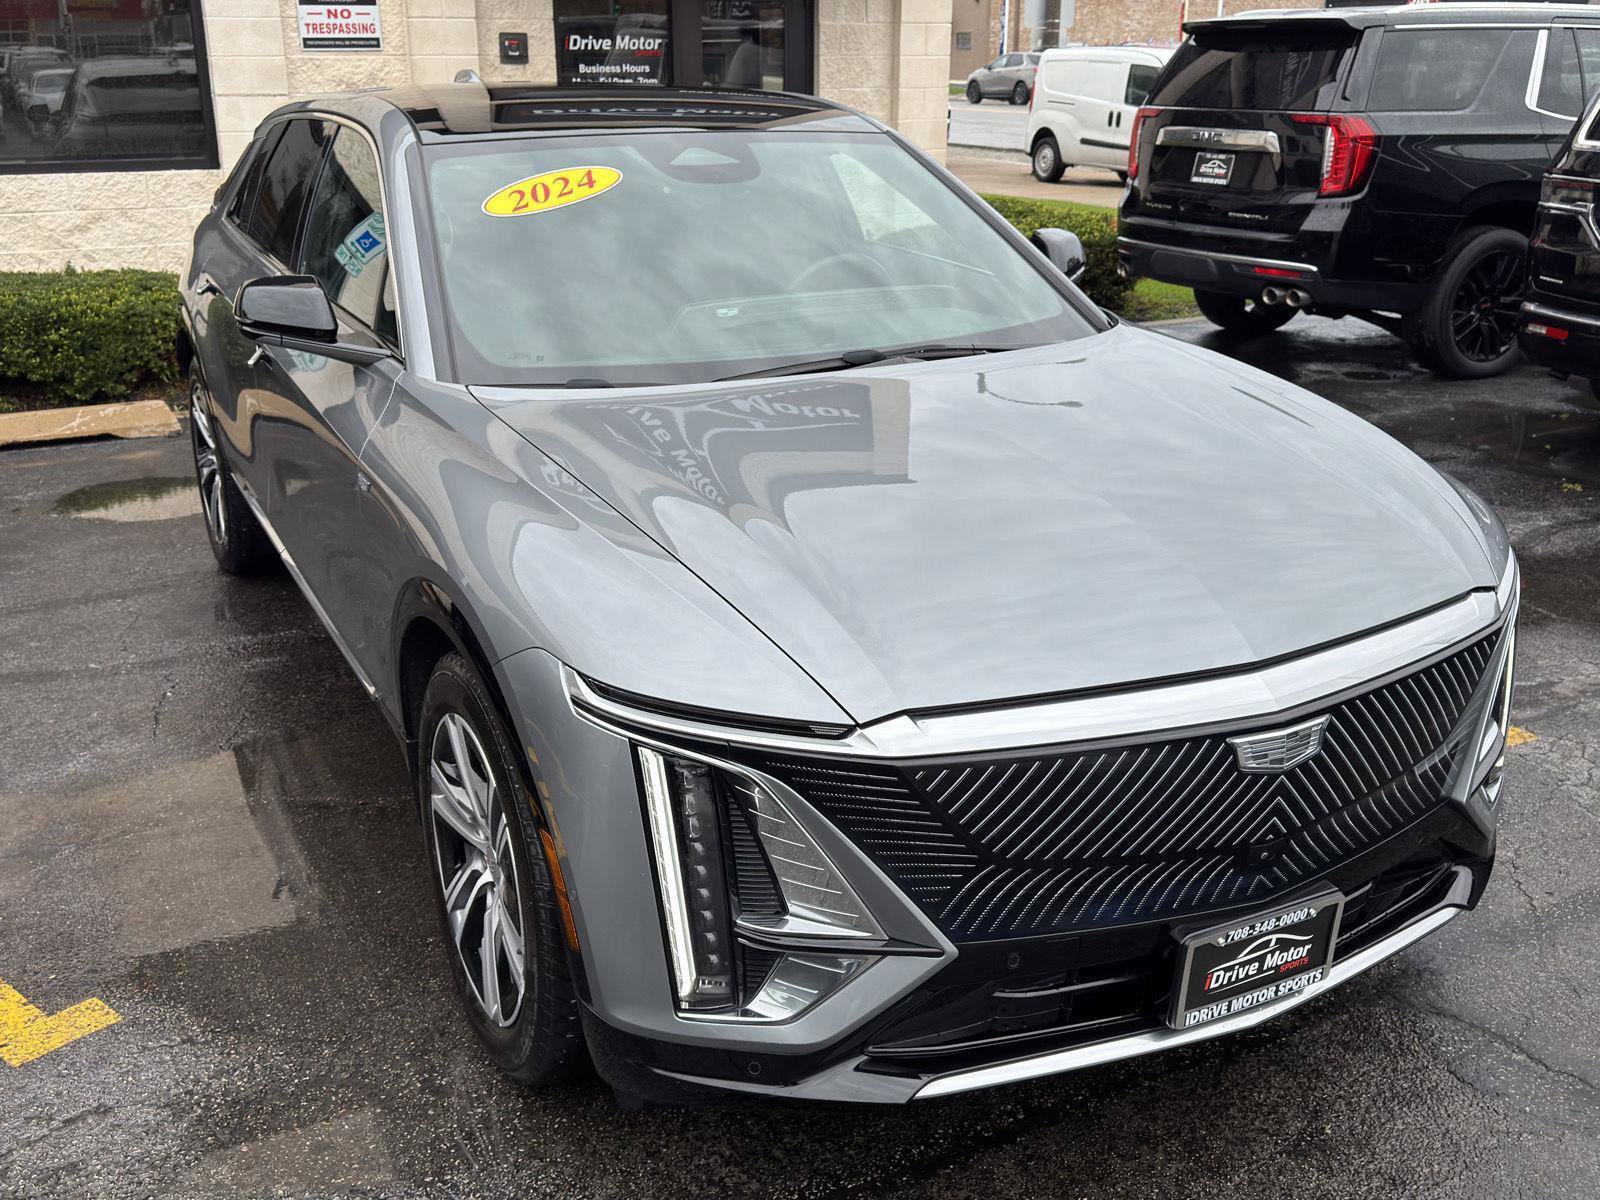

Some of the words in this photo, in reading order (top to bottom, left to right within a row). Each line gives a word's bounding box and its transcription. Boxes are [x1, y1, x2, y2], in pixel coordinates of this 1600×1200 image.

[326, 9, 352, 19] NO
[305, 22, 376, 34] TRESPASSING
[564, 35, 612, 50] iDrive
[615, 35, 662, 50] Motor
[579, 64, 621, 73] Business
[622, 63, 651, 73] Hours
[508, 169, 596, 212] 2024
[1226, 908, 1309, 943] 708-348-0000
[1204, 963, 1258, 992] iDrive
[1263, 944, 1312, 973] Motor
[1279, 957, 1310, 973] SPORTS
[1232, 989, 1275, 1012] MOTOR
[1278, 970, 1322, 996] SPORTS
